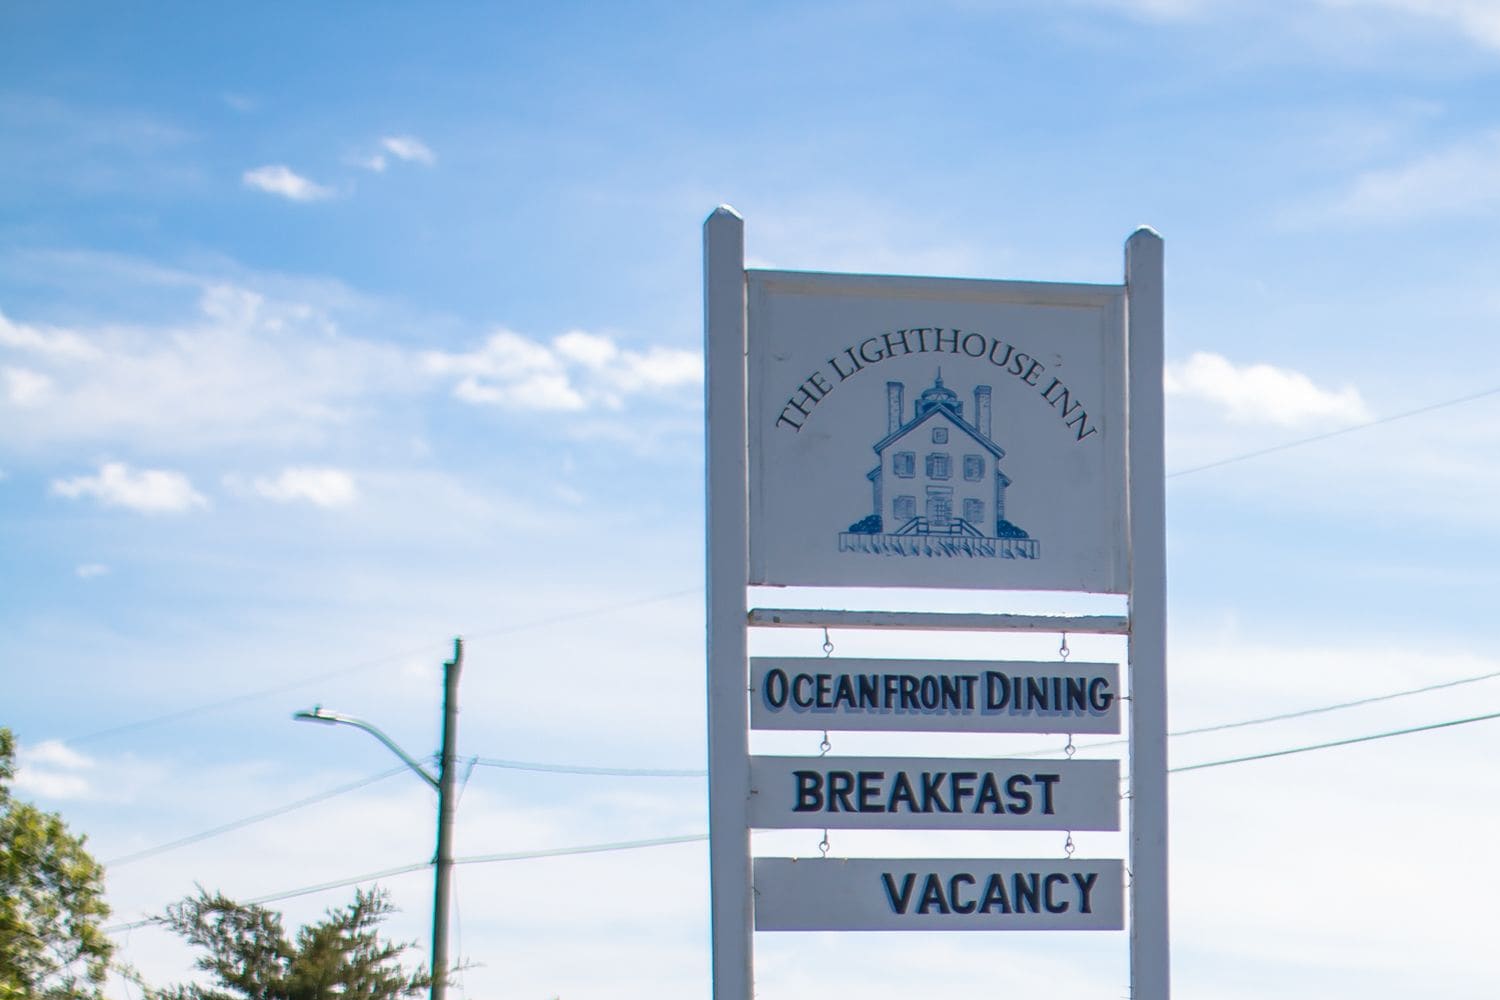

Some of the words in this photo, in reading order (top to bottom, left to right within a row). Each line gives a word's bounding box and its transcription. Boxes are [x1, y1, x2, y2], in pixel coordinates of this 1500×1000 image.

[776, 371, 834, 433] THE
[828, 327, 1045, 388] LIGHTHOUSE
[1040, 378, 1098, 442] INN
[764, 668, 979, 710] OCEANFRONT
[985, 670, 1115, 712] DINING
[791, 770, 1061, 815] BREAKFAST
[881, 872, 1099, 915] VACANCY
